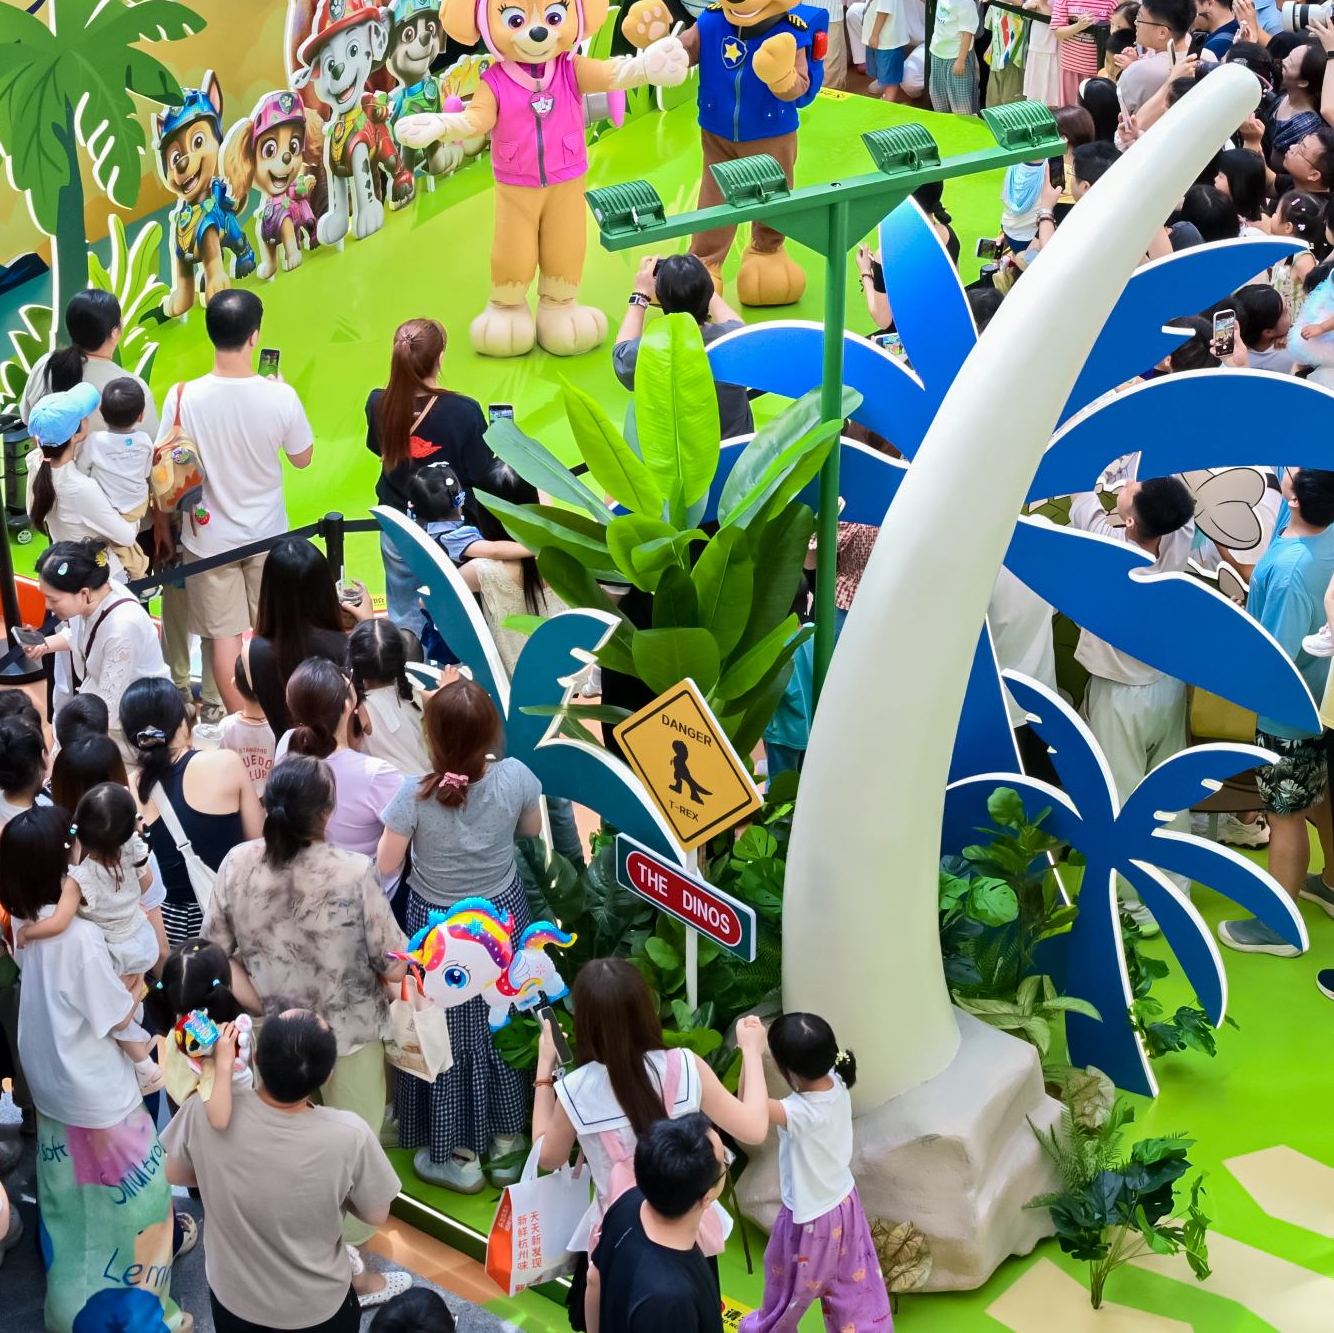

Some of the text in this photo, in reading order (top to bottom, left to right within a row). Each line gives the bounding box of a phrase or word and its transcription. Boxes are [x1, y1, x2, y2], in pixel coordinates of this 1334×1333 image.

[661, 713, 713, 748] DANGER
[668, 798, 700, 822] T-REX
[637, 861, 731, 936] THE DINOS
[516, 1214, 529, 1271] 新鲜杭州味
[529, 1211, 543, 1269] 天天新发现
